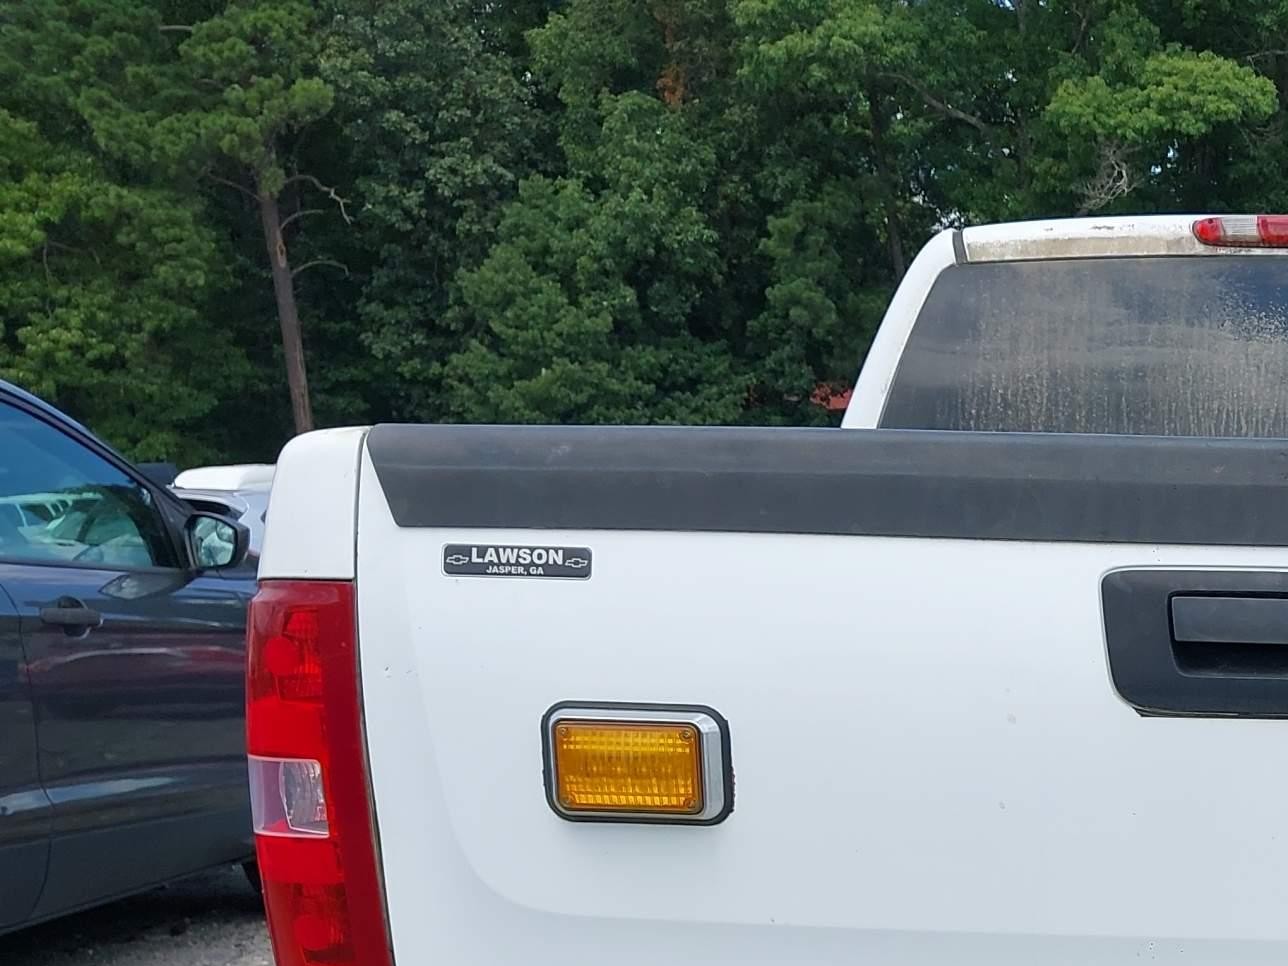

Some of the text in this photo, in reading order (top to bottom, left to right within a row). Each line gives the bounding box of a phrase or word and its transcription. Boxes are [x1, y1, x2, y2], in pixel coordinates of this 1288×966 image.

[471, 547, 564, 565] LAWSON
[486, 565, 544, 576] JASPER, GA
